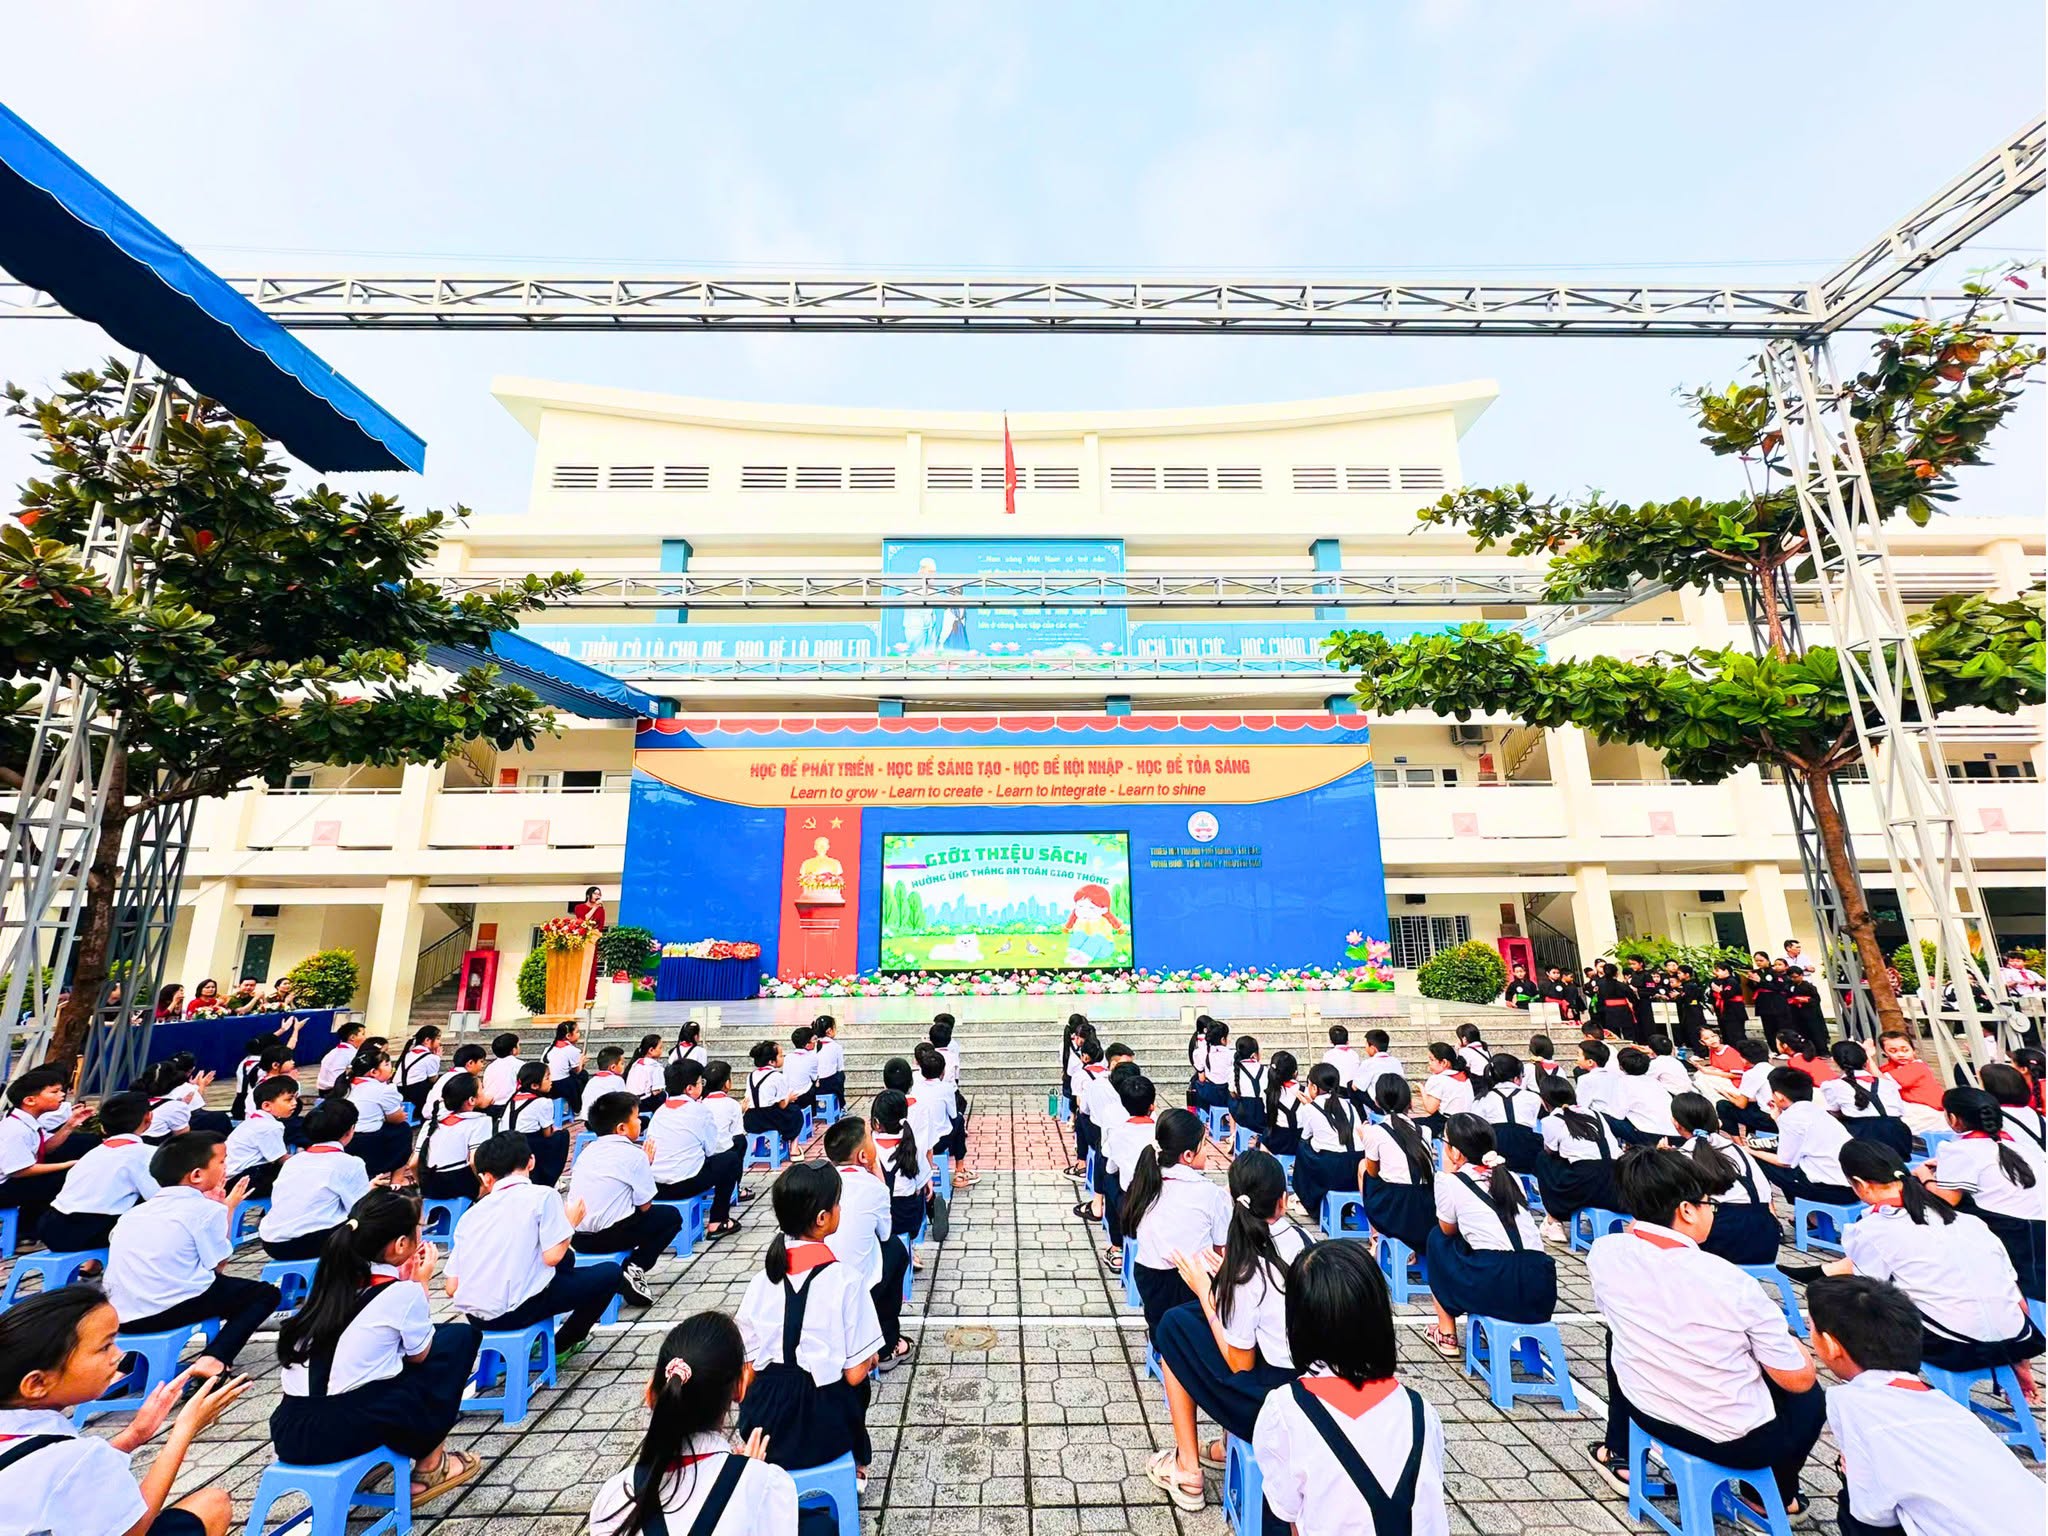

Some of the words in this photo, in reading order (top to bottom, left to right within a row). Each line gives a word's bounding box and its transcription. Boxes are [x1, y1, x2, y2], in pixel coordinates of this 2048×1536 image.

[750, 763, 777, 780] HỌC
[781, 756, 798, 777] ĐỂ
[802, 759, 835, 777] PHÁT
[838, 755, 874, 777] TRIỂN
[886, 762, 913, 779] HỌC
[917, 755, 934, 776] ĐỂ
[938, 758, 973, 776] SÁNG
[977, 761, 1002, 778] TẠO
[1014, 760, 1039, 778] HỌC
[1043, 754, 1060, 775] ĐỂ
[1063, 757, 1085, 777] HỘI
[1088, 756, 1124, 777] NHẬP
[1136, 760, 1162, 777] HỌC
[1166, 753, 1183, 774] ĐỂ
[1186, 754, 1211, 774] TỎA
[1215, 756, 1251, 774] SÁNG
[790, 786, 827, 799] Learn
[830, 787, 842, 799] to
[845, 788, 878, 802] grow
[889, 786, 926, 798] Learn
[928, 786, 940, 798] to
[943, 785, 983, 798] create
[996, 784, 1033, 797] Learn
[1036, 785, 1049, 797] to
[1118, 784, 1155, 796] Learn
[1157, 784, 1170, 796] to
[1172, 784, 1206, 796] shine
[924, 846, 971, 867] GIỚI
[975, 843, 1034, 864] THIỆU
[1038, 846, 1088, 865] SÁCH
[948, 869, 969, 884] ỨNG
[971, 866, 1004, 876] THÁNG
[1006, 867, 1021, 876] AN
[1022, 867, 1048, 877] TOÀN
[1050, 868, 1075, 879] GIAO
[1077, 872, 1110, 886] THÔNG
